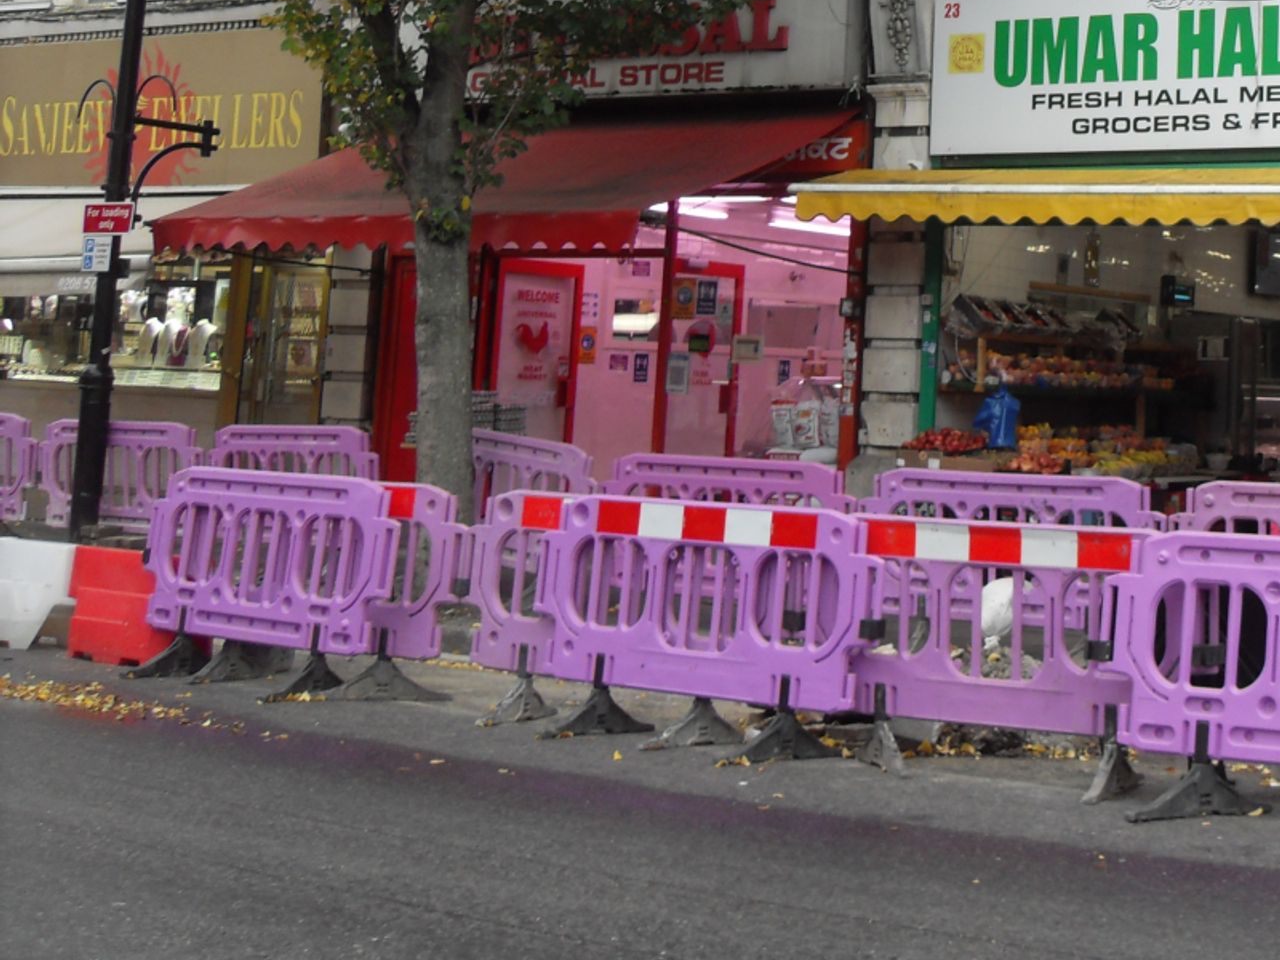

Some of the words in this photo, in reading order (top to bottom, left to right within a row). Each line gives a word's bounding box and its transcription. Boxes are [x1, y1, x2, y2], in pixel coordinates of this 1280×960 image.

[944, 3, 961, 19] 23
[993, 12, 1159, 88] UMAR
[620, 61, 726, 86] STORE
[1031, 91, 1123, 110] FRESH
[1134, 87, 1228, 106] HALAL
[1071, 113, 1211, 135] GROCERS
[1222, 113, 1242, 130] &
[87, 207, 100, 217] For
[101, 206, 130, 219] loading
[98, 220, 115, 230] only
[517, 289, 560, 304] WELCOME
